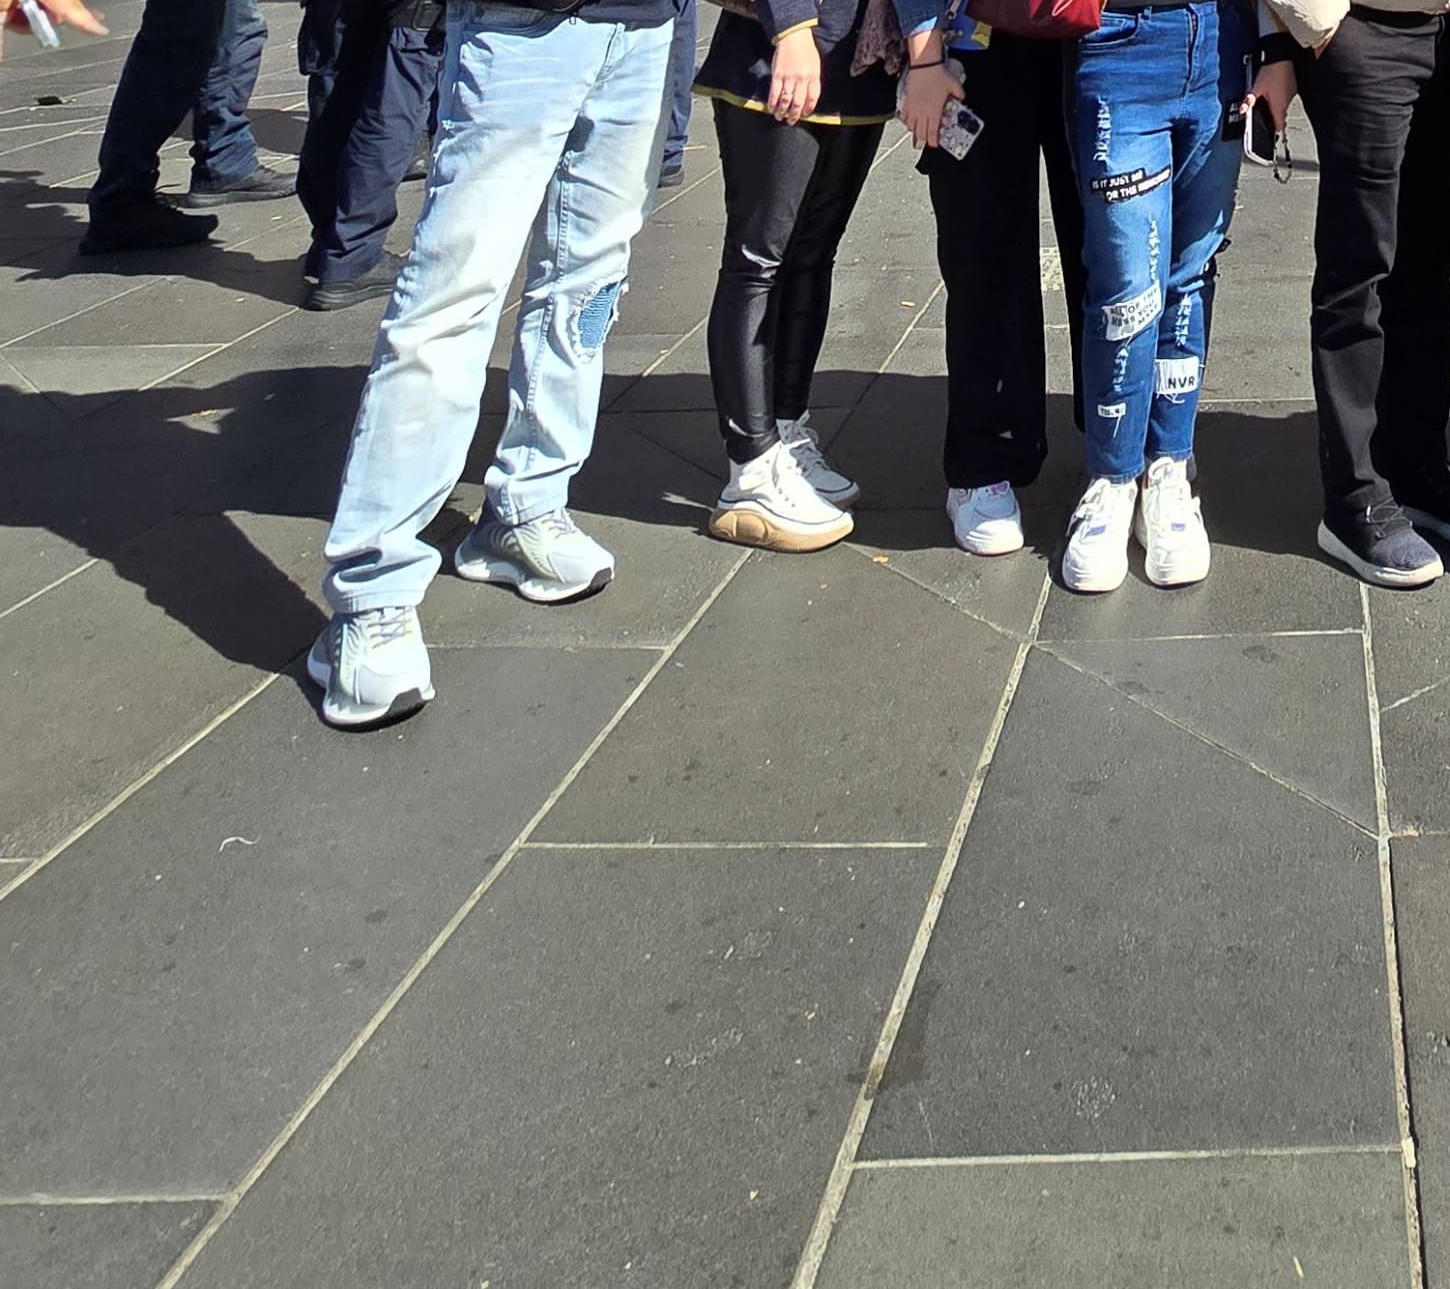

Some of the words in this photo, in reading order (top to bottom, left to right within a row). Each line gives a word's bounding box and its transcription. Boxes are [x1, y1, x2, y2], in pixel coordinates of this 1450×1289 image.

[1109, 175, 1129, 187] JUST
[1106, 190, 1119, 201] OR
[1120, 185, 1138, 197] THE
